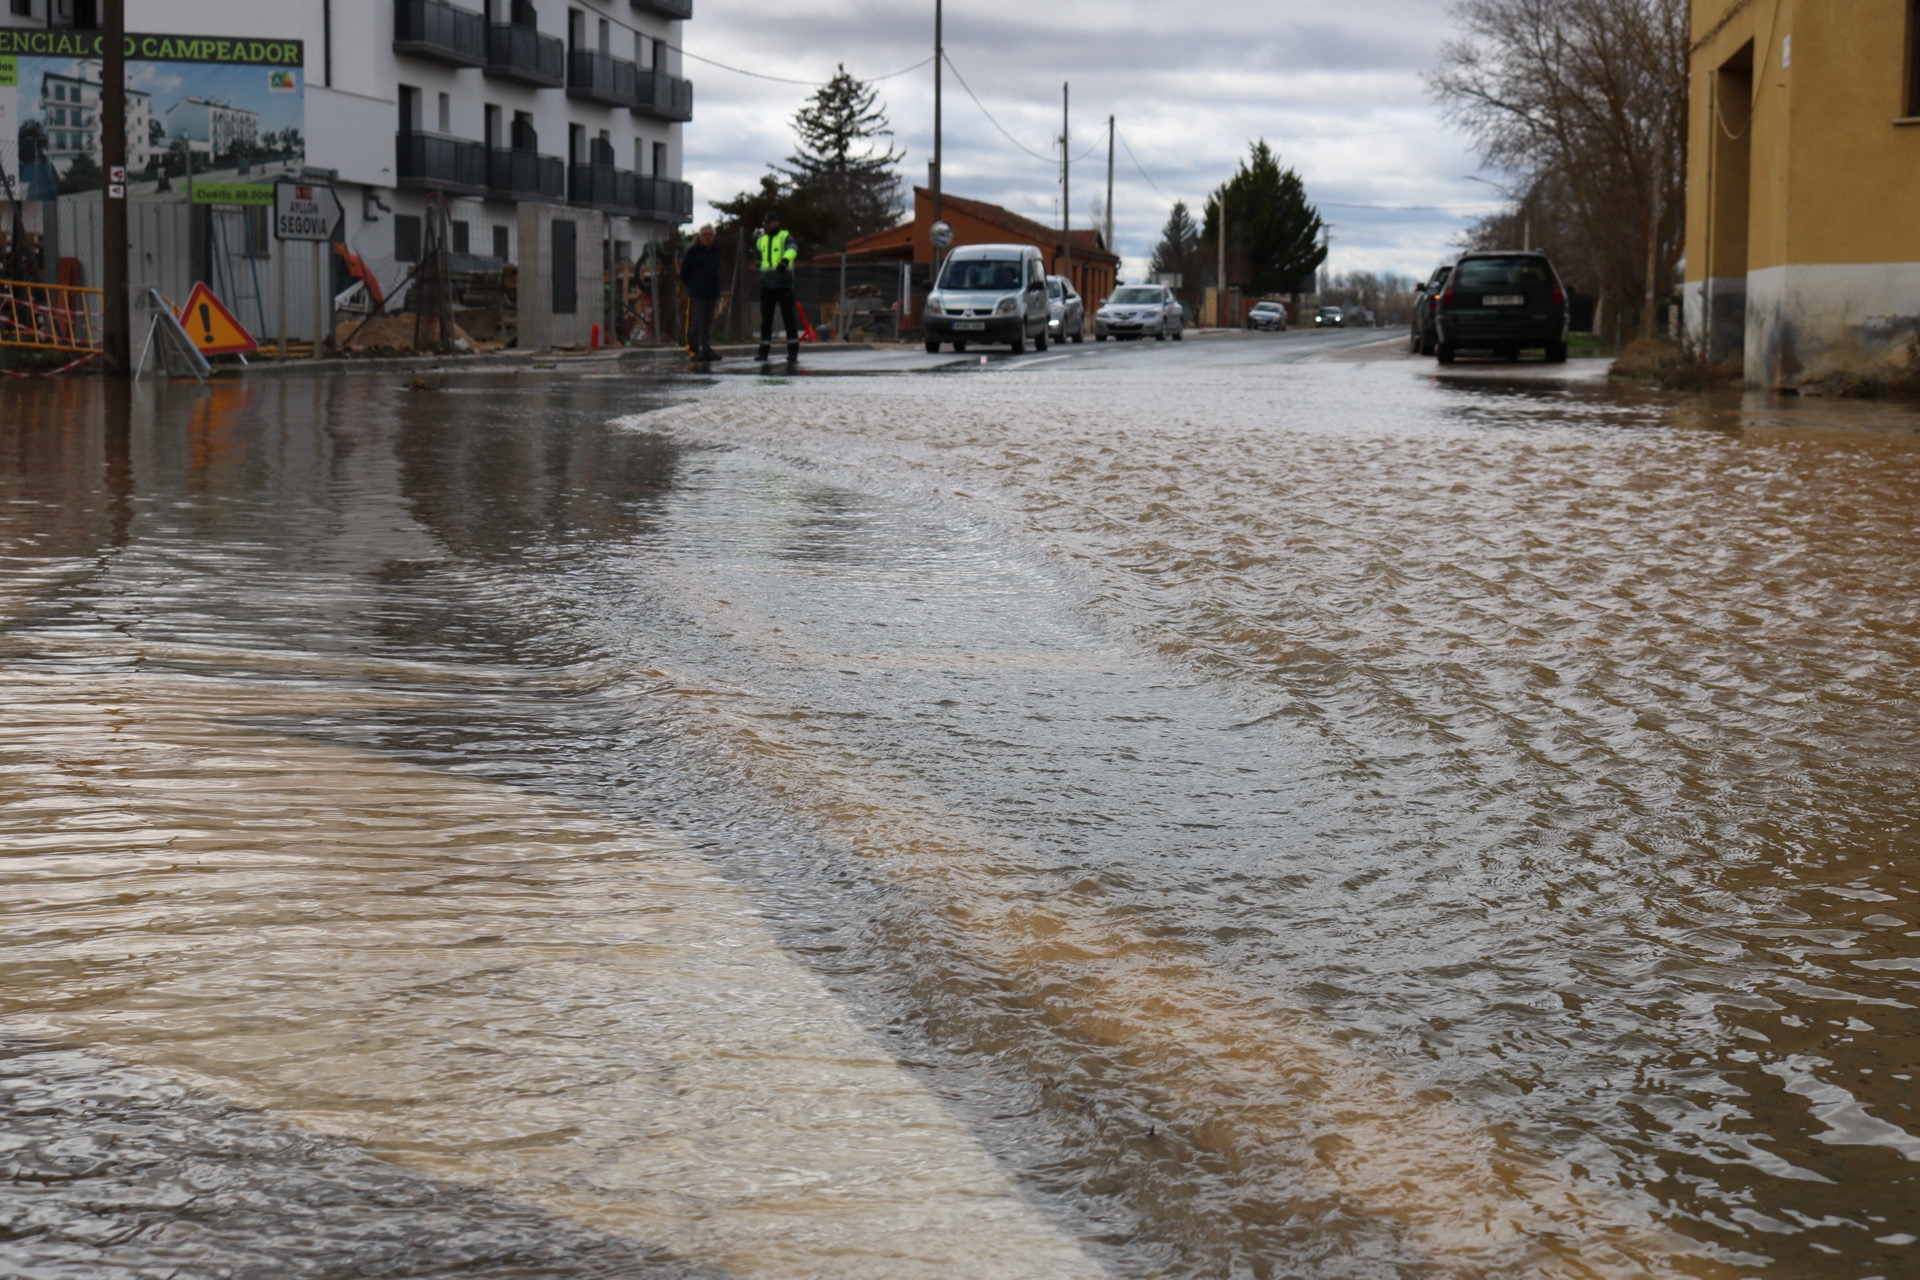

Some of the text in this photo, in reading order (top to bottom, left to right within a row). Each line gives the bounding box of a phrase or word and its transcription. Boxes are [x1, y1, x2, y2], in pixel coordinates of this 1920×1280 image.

[93, 35, 137, 57] CD
[141, 37, 299, 63] CAMPEADOR
[196, 188, 232, 200] Desde
[280, 215, 327, 236] SEGOVIA
